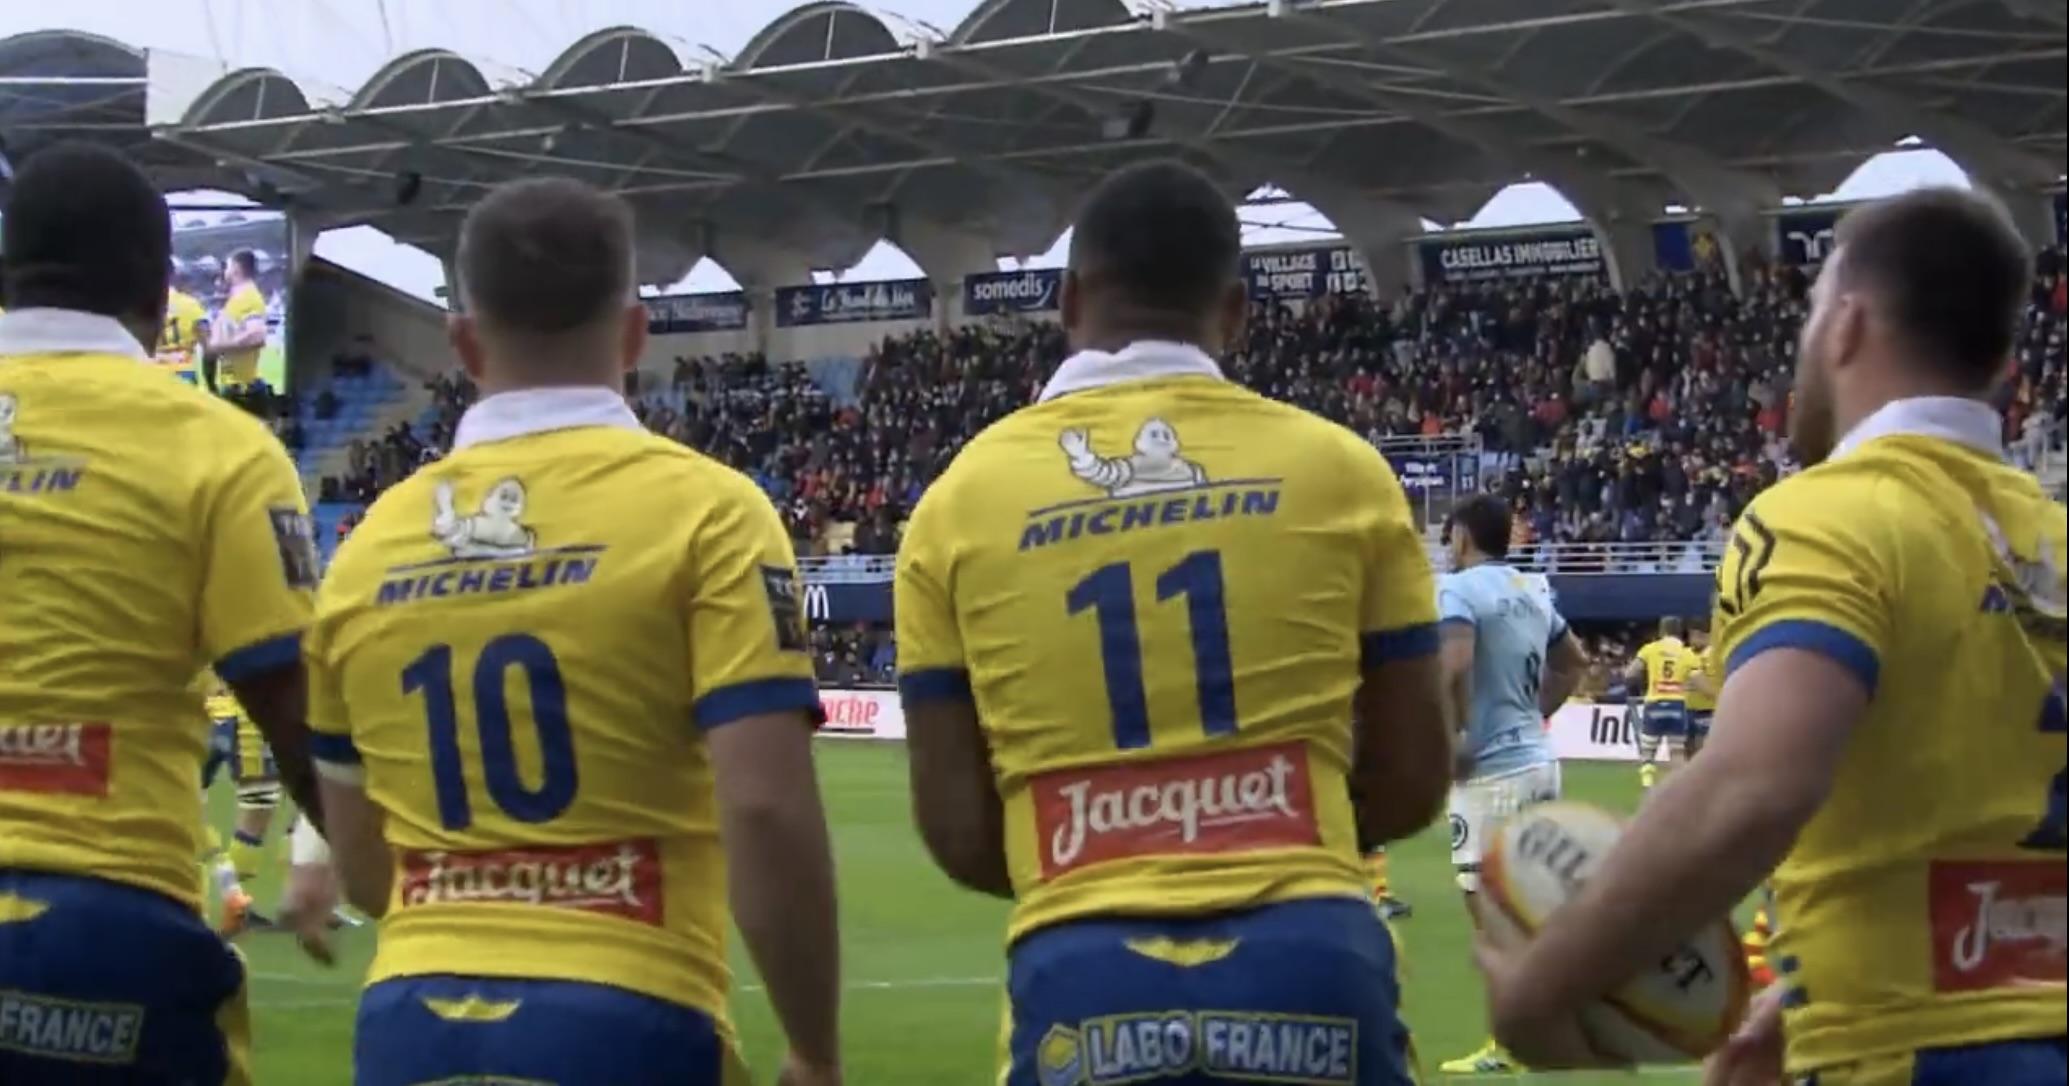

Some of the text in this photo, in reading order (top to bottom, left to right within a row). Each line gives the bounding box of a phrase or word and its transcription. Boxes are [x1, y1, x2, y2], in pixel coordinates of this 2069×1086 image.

[1270, 273, 1313, 292] SPORT
[1440, 245, 1512, 268] CASELLAS
[0, 467, 84, 493] LIN
[1018, 489, 1281, 552] MICHELIN
[375, 556, 600, 606] MICHELIN
[1066, 549, 1238, 749] 11
[402, 632, 578, 831] 10
[1051, 754, 1299, 865] Jacquet
[0, 1000, 137, 1055] FRANCE
[1090, 1020, 1349, 1077] LABO FRANCE
